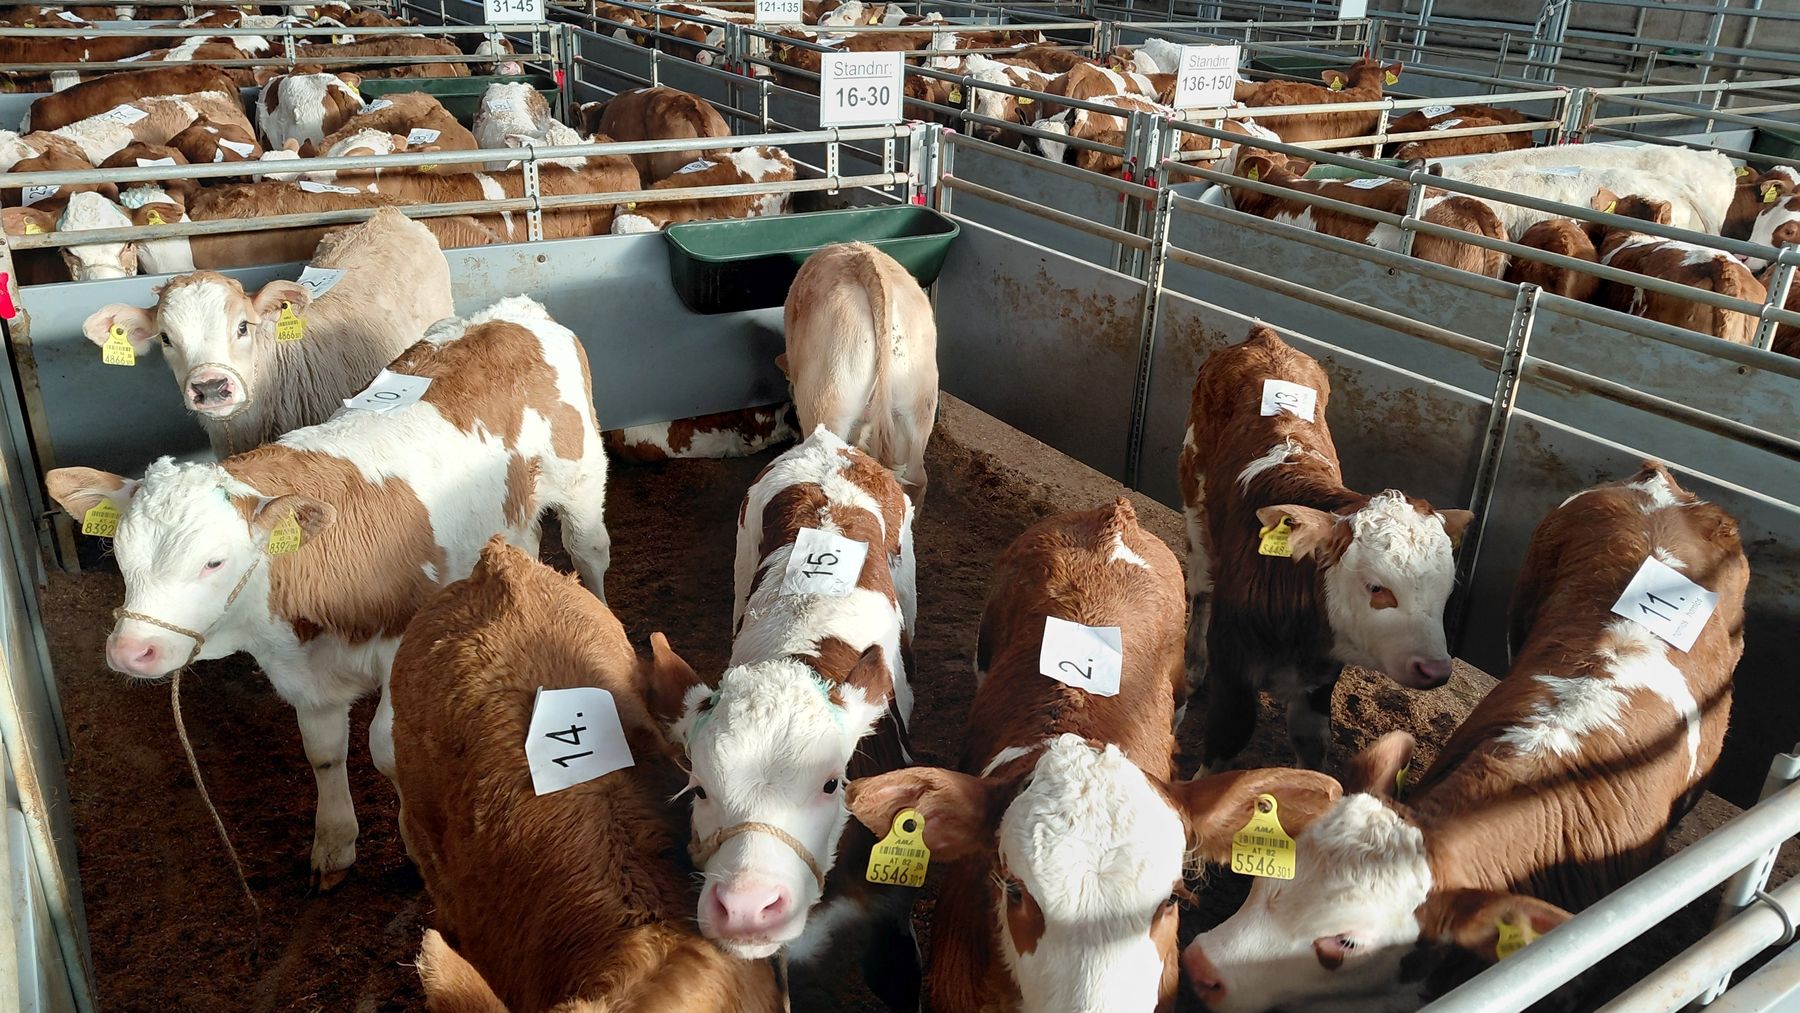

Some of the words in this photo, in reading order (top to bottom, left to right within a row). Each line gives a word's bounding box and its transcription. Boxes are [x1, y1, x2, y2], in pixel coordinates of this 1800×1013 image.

[493, 0, 534, 12] 31-45
[758, 1, 799, 12] 121-135
[833, 60, 892, 76] Standnr:
[1182, 75, 1233, 91] 136-150
[836, 86, 890, 107] 16-30
[85, 522, 115, 536] 8392
[801, 549, 842, 579] 15.
[1638, 591, 1686, 622] 11.
[1058, 657, 1094, 680] 2.
[545, 711, 594, 769] 14.
[1252, 847, 1261, 856] AT
[889, 857, 899, 865] AT
[1234, 853, 1275, 876] 5546
[870, 863, 909, 884] 5546
